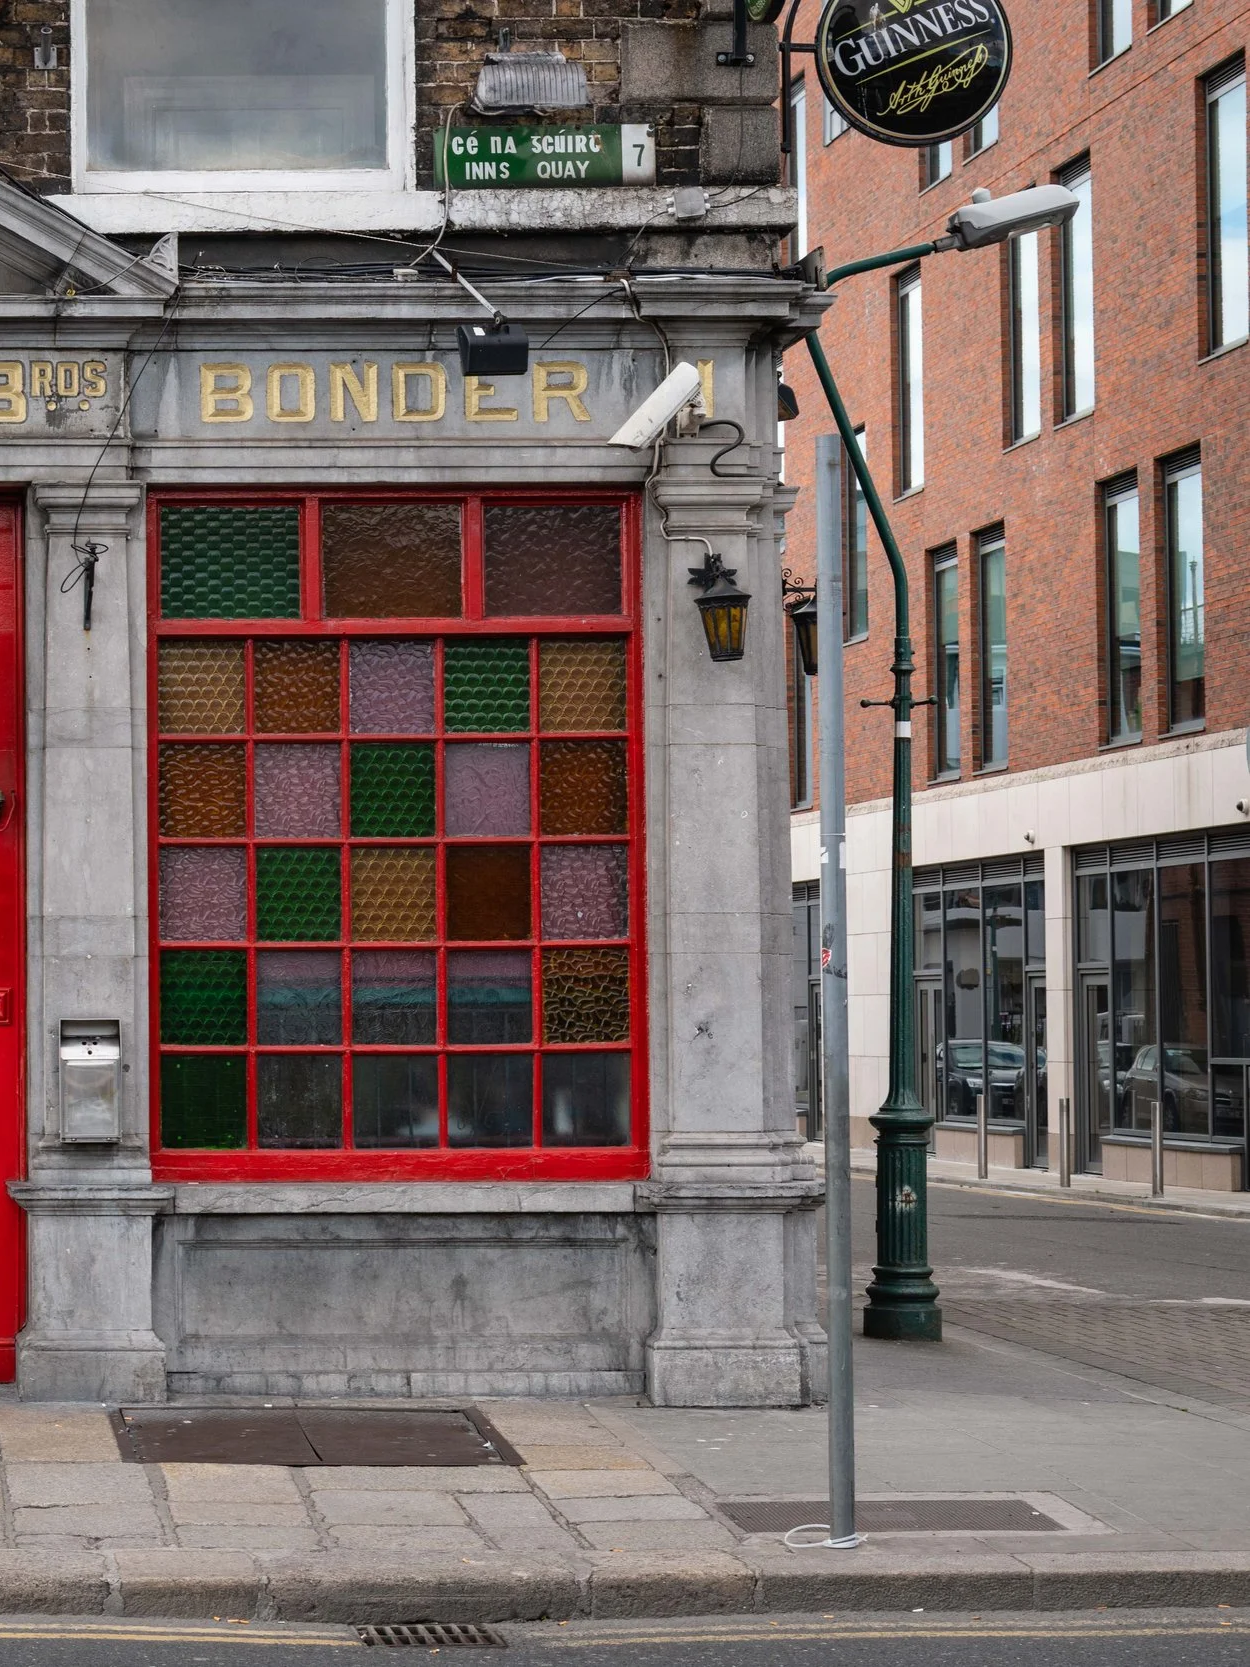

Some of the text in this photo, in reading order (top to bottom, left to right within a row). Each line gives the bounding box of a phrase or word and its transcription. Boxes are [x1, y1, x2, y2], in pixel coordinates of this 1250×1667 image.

[834, 0, 990, 76] GUINNESS
[465, 160, 590, 180] INNS QUAY
[632, 143, 646, 167] 7
[200, 361, 592, 423] BONDER
